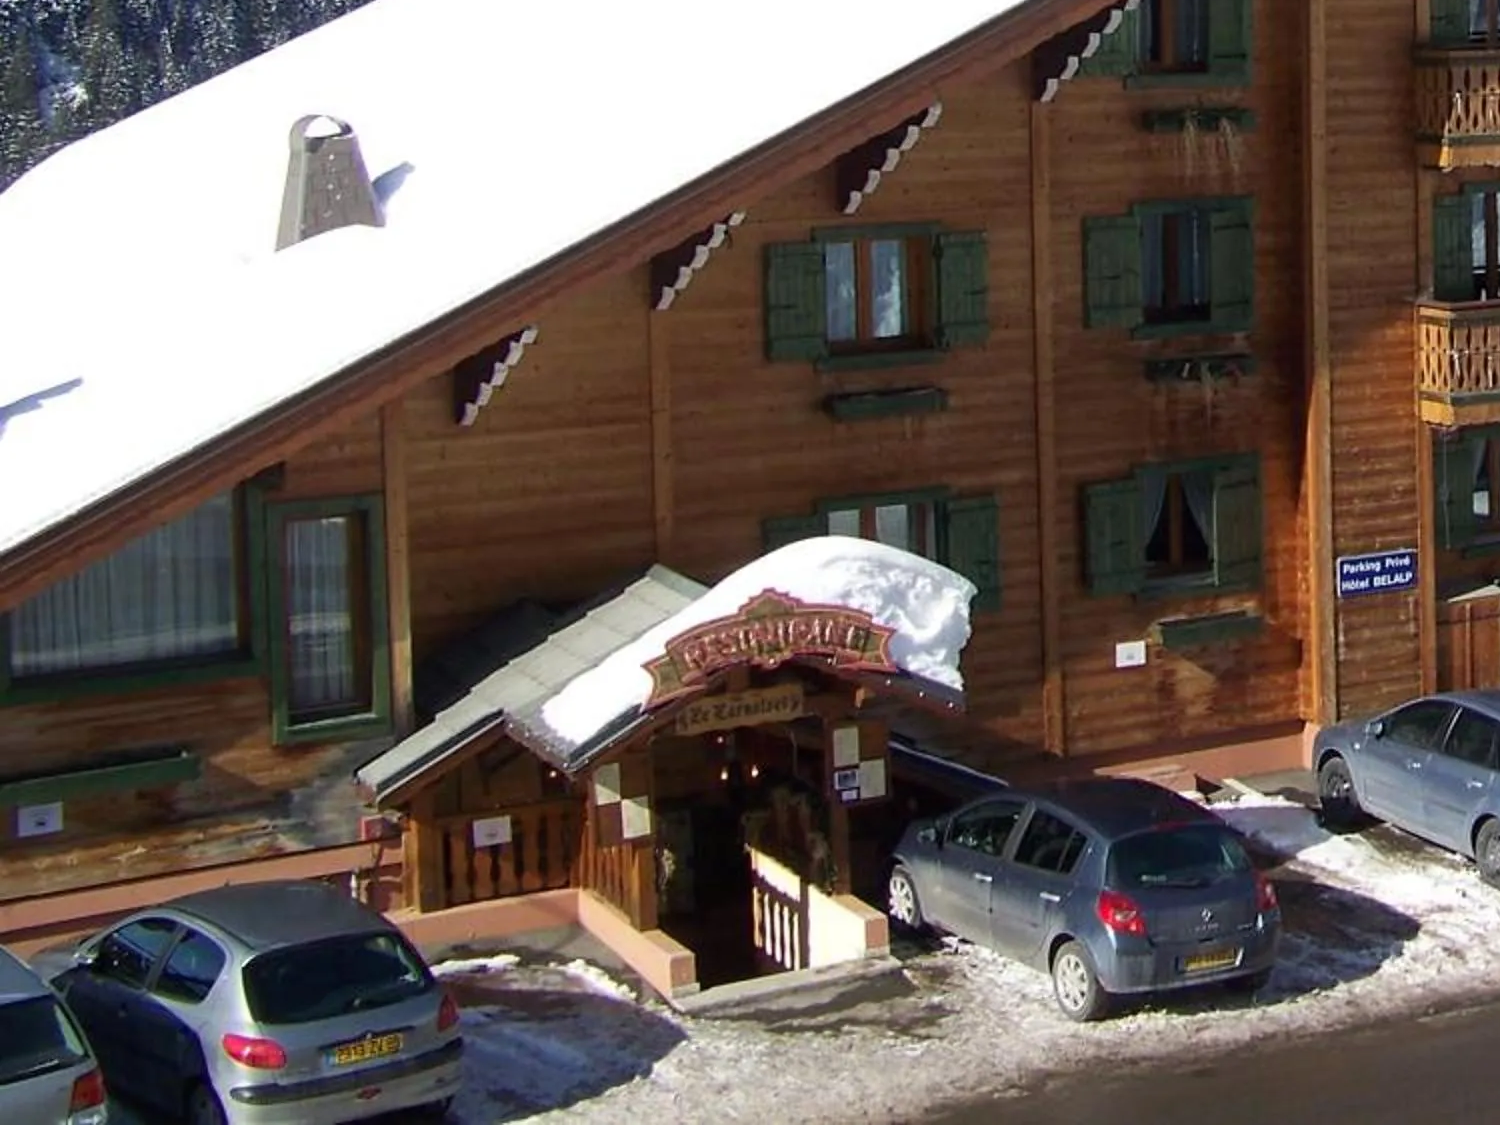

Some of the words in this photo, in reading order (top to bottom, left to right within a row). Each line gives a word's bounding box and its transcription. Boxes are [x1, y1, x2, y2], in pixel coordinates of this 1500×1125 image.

[1343, 559, 1381, 574] Parking
[1385, 555, 1411, 568] Privé
[1373, 571, 1413, 588] BELALP
[684, 617, 870, 671] RESTAURANT
